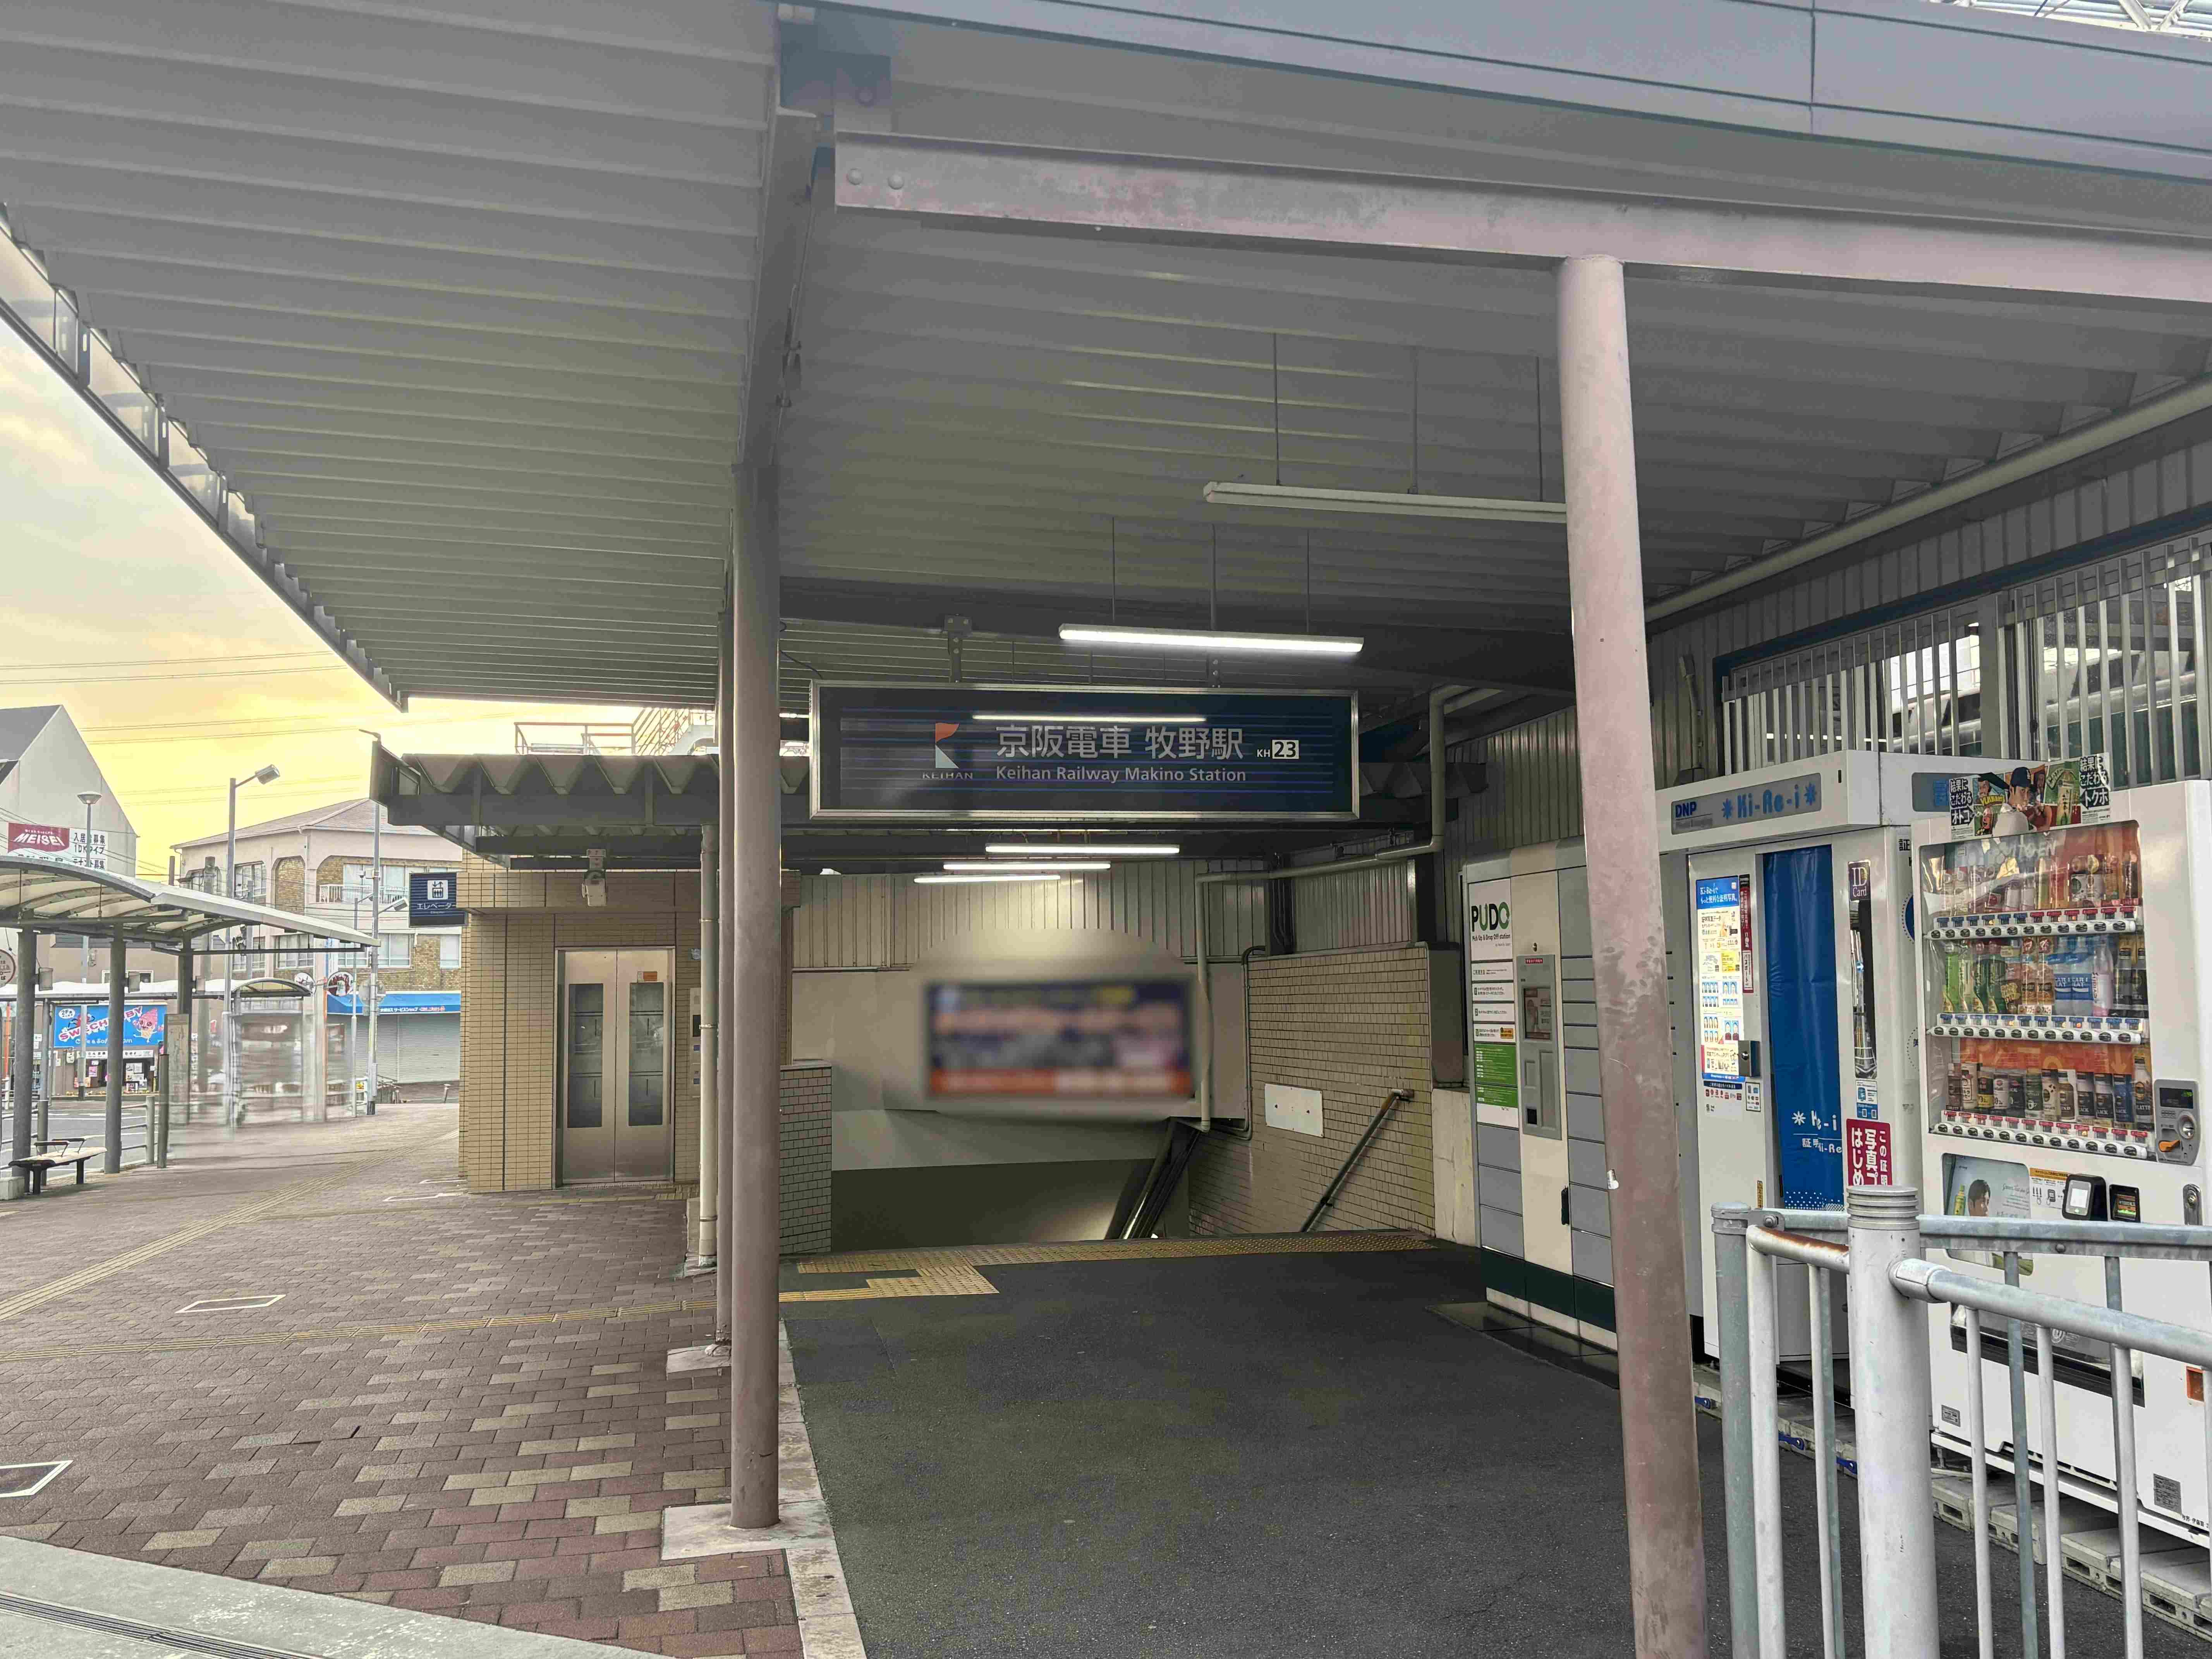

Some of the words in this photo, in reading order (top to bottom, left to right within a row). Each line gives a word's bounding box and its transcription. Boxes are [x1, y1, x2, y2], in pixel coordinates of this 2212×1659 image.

[996, 724, 1132, 758] 京阪電車
[1145, 725, 1243, 759] 牧野駅
[1257, 749, 1270, 757] KH
[1274, 741, 1296, 757] 23
[996, 766, 1051, 780] Keihan
[1057, 766, 1119, 783] Railway
[1125, 767, 1184, 781] Makino
[1189, 768, 1246, 781] Station
[1951, 779, 1968, 792] 結果に
[1951, 792, 1972, 805] こだわる
[2085, 788, 2108, 807] トクホ
[1675, 801, 1697, 817] DNP
[1952, 810, 1970, 824] オトコ
[13, 833, 65, 847] MEISEI
[1851, 867, 1867, 886] ID
[1853, 886, 1867, 897] Card
[1472, 902, 1510, 932] PUDO
